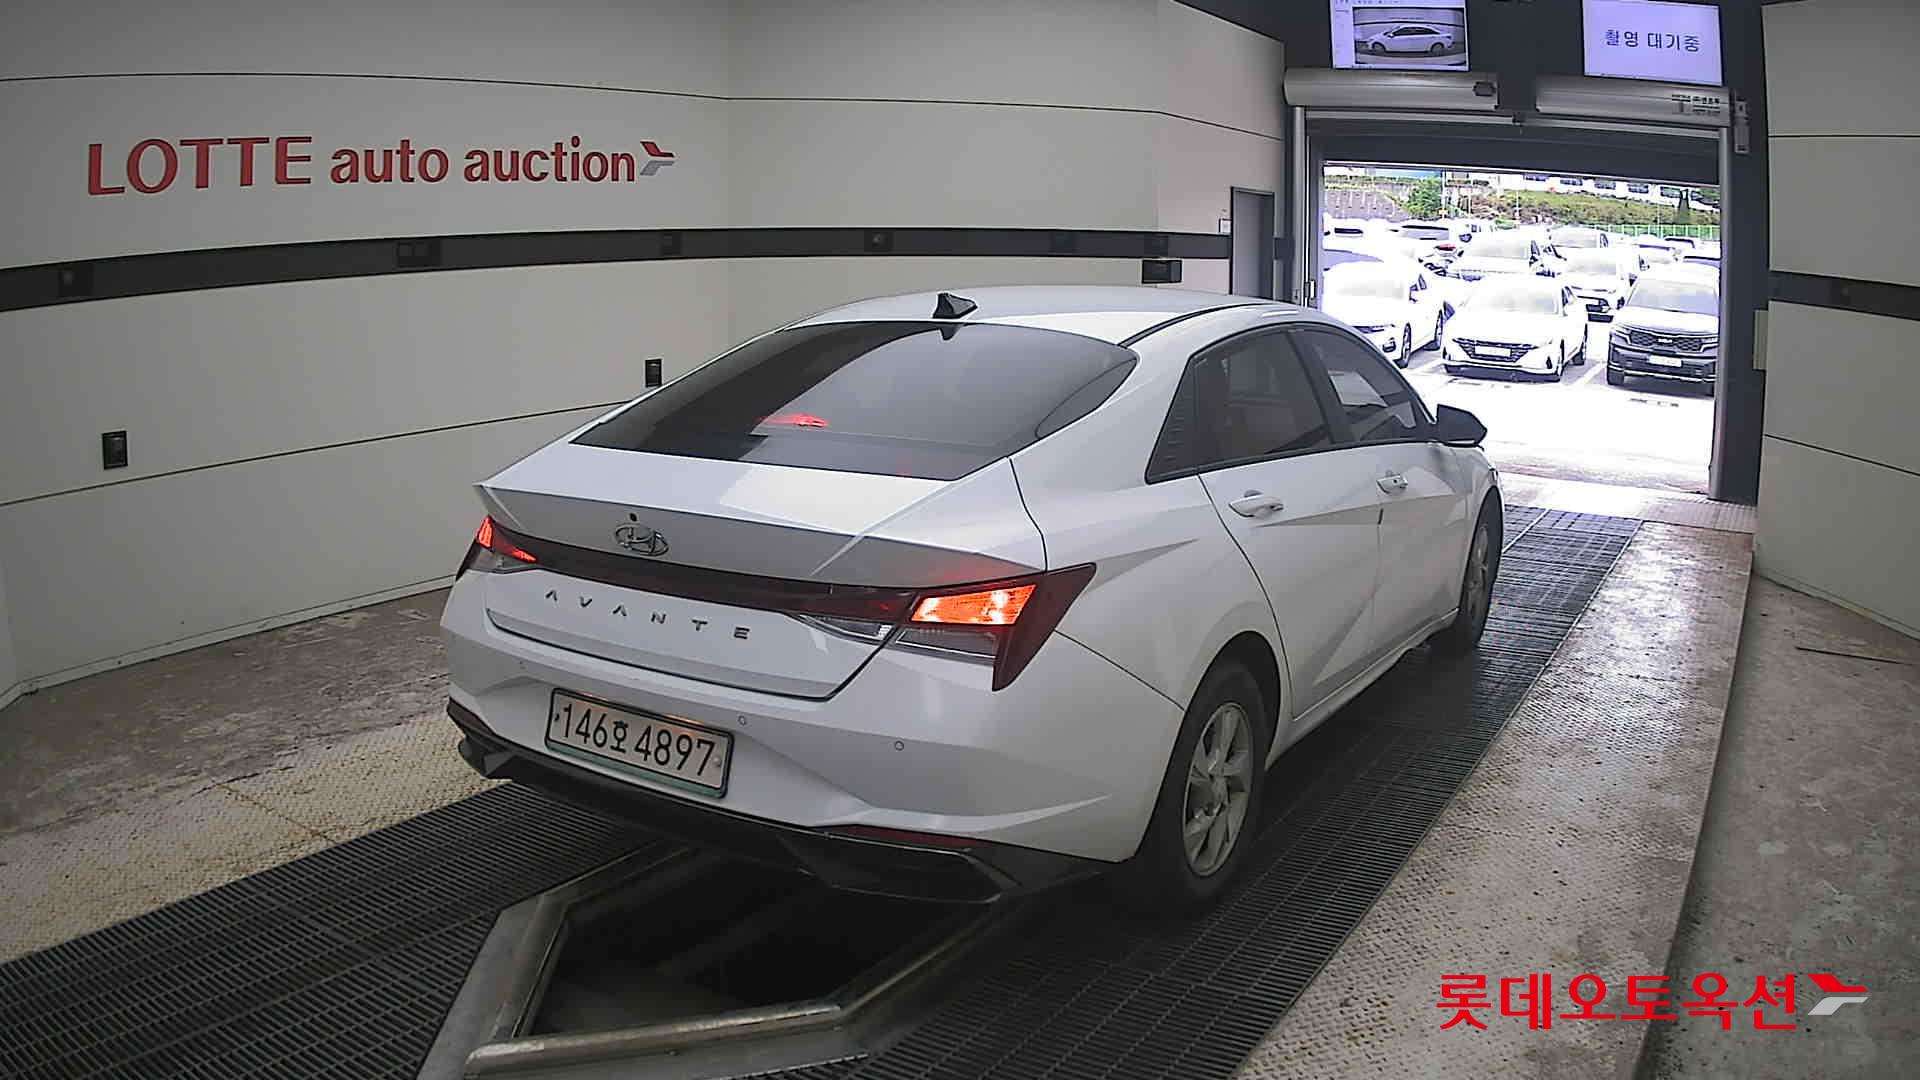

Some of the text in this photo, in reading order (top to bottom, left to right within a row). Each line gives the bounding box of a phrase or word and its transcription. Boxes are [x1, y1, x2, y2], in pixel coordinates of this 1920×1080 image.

[1647, 32, 1700, 52] 대기중
[88, 135, 636, 195] LOTTE auto auction
[545, 589, 750, 639] AVANTE
